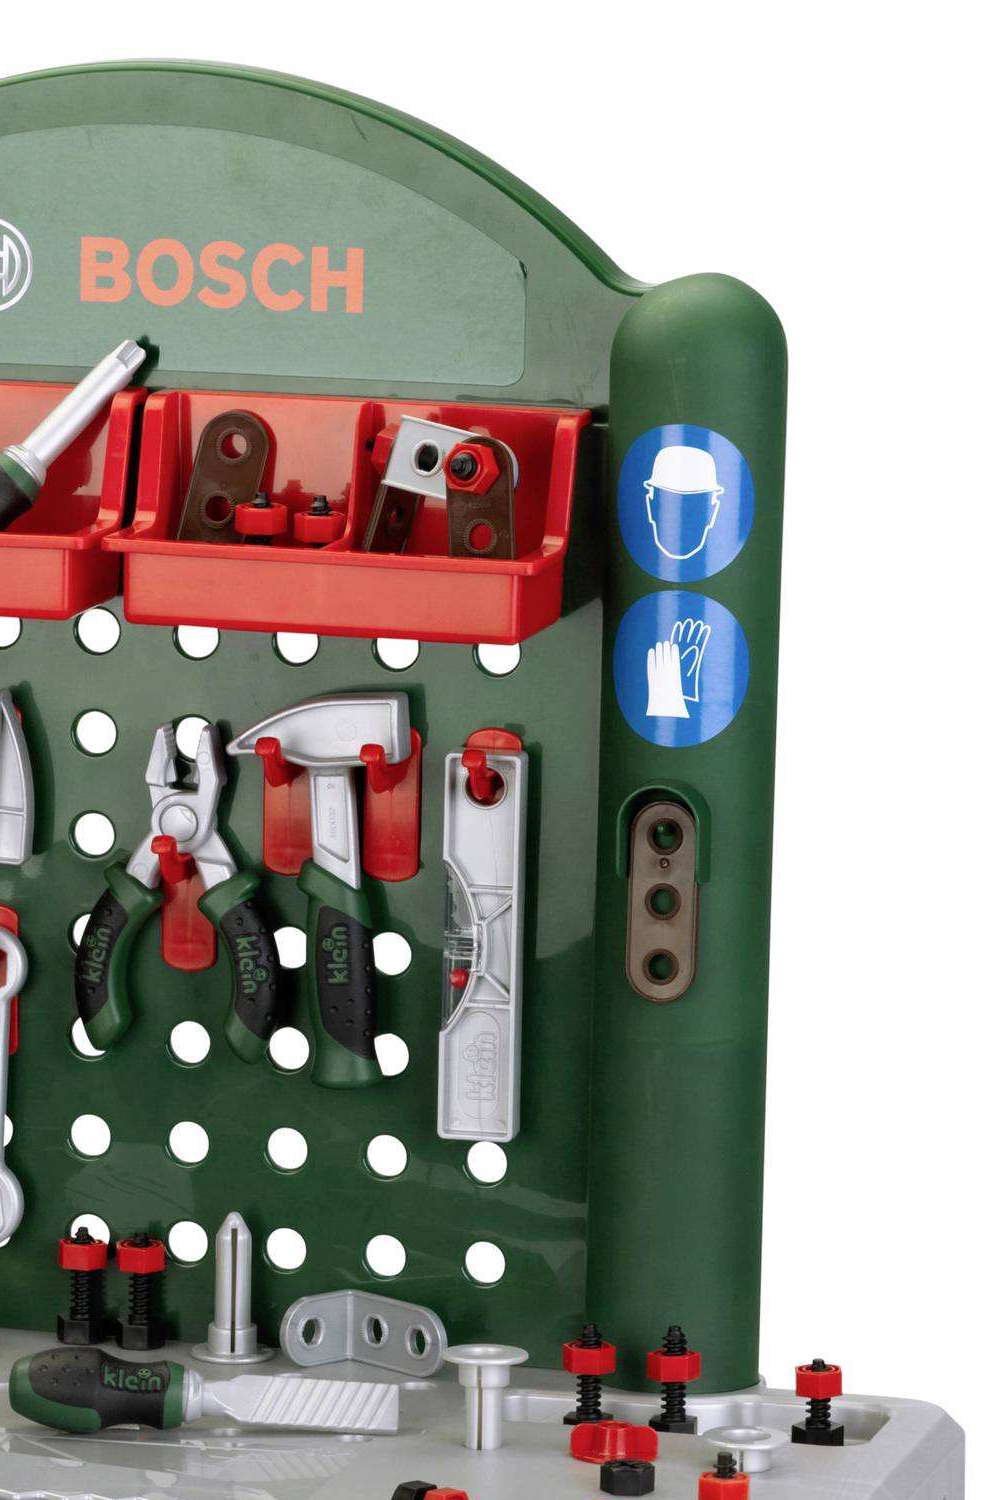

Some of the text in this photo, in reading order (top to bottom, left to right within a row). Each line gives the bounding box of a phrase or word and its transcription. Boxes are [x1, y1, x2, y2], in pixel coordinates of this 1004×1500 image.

[80, 235, 365, 314] BOSCH
[82, 926, 113, 984] klein
[234, 933, 269, 995] klein
[321, 925, 350, 985] klein
[462, 1031, 496, 1101] klein
[103, 1365, 162, 1392] klein
